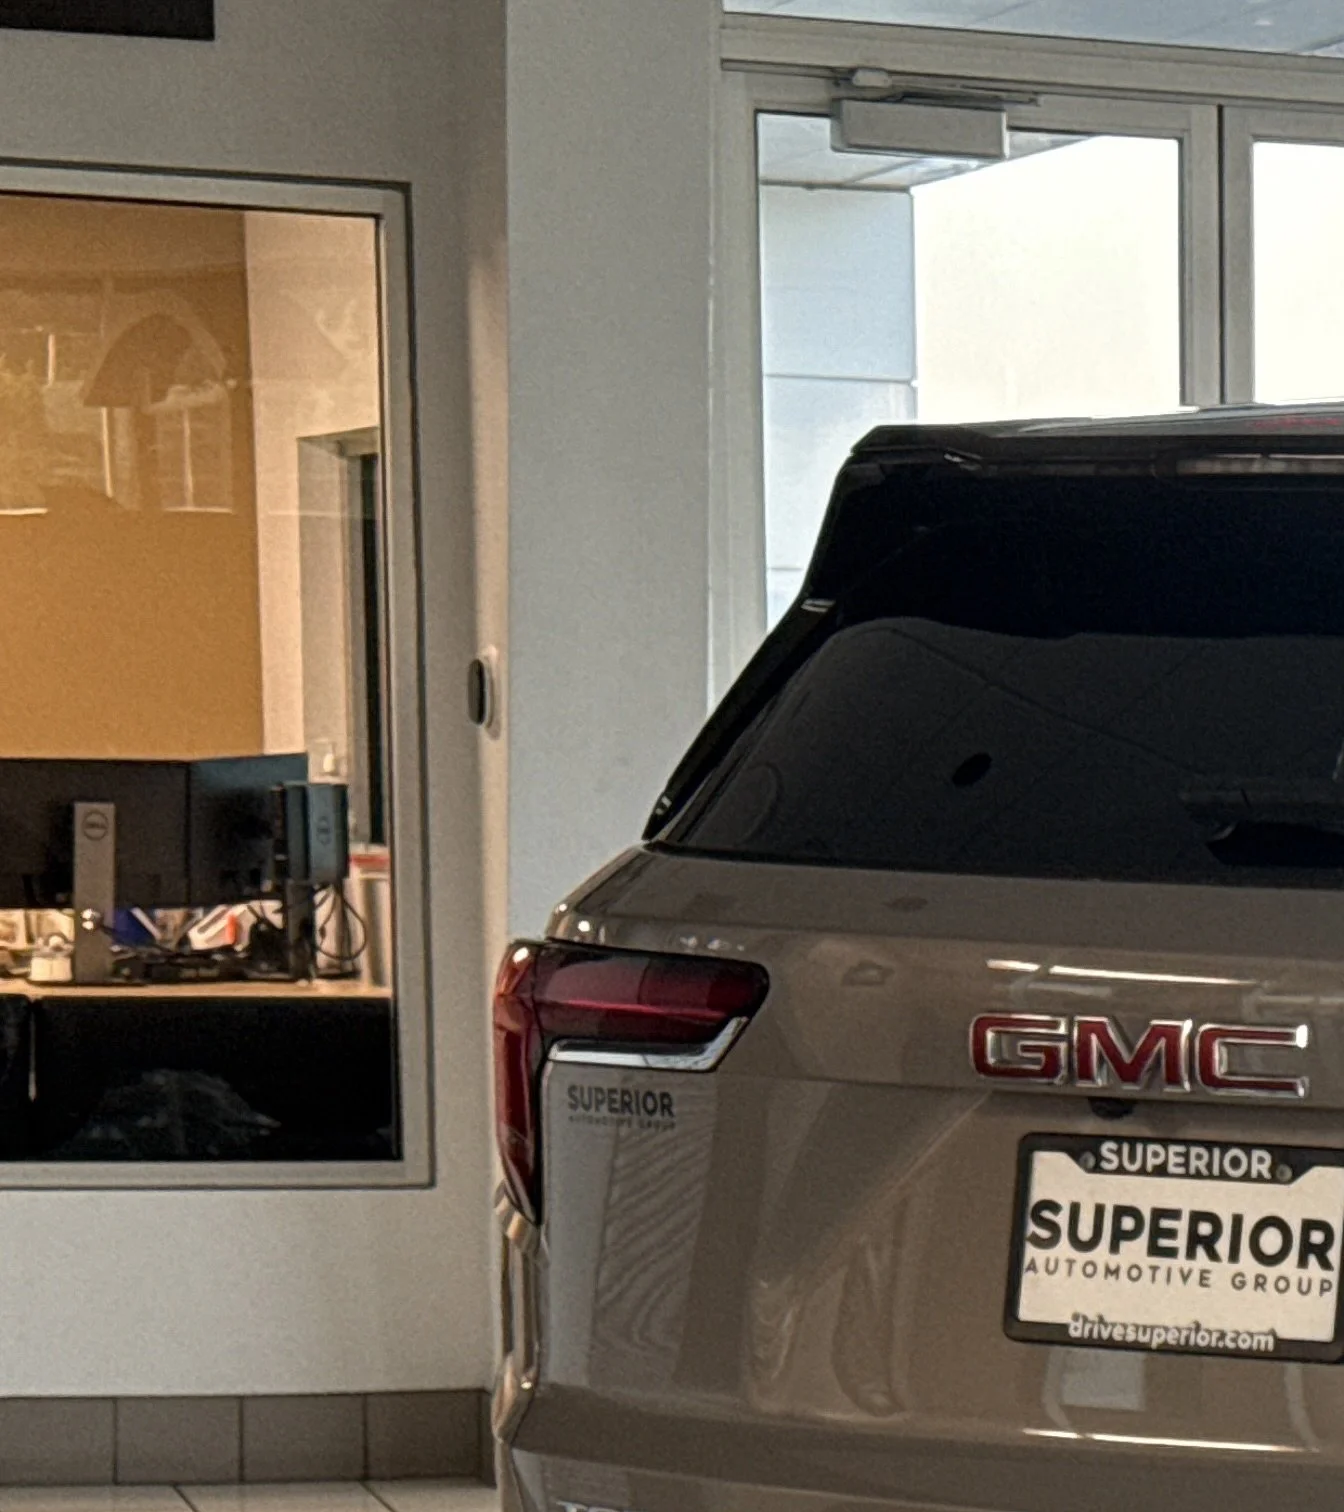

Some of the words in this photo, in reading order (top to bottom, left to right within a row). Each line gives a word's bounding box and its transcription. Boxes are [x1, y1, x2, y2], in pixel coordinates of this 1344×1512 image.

[970, 1012, 1308, 1098] GMC
[567, 1084, 675, 1118] SUPERIOR
[1100, 1140, 1273, 1180] SUPERIOR
[1025, 1198, 1336, 1272] SUPERIOR
[1024, 1256, 1213, 1289] AUTOMOTIVE
[1230, 1270, 1334, 1298] GROUP
[1068, 1312, 1275, 1352] drivesuperior.com
